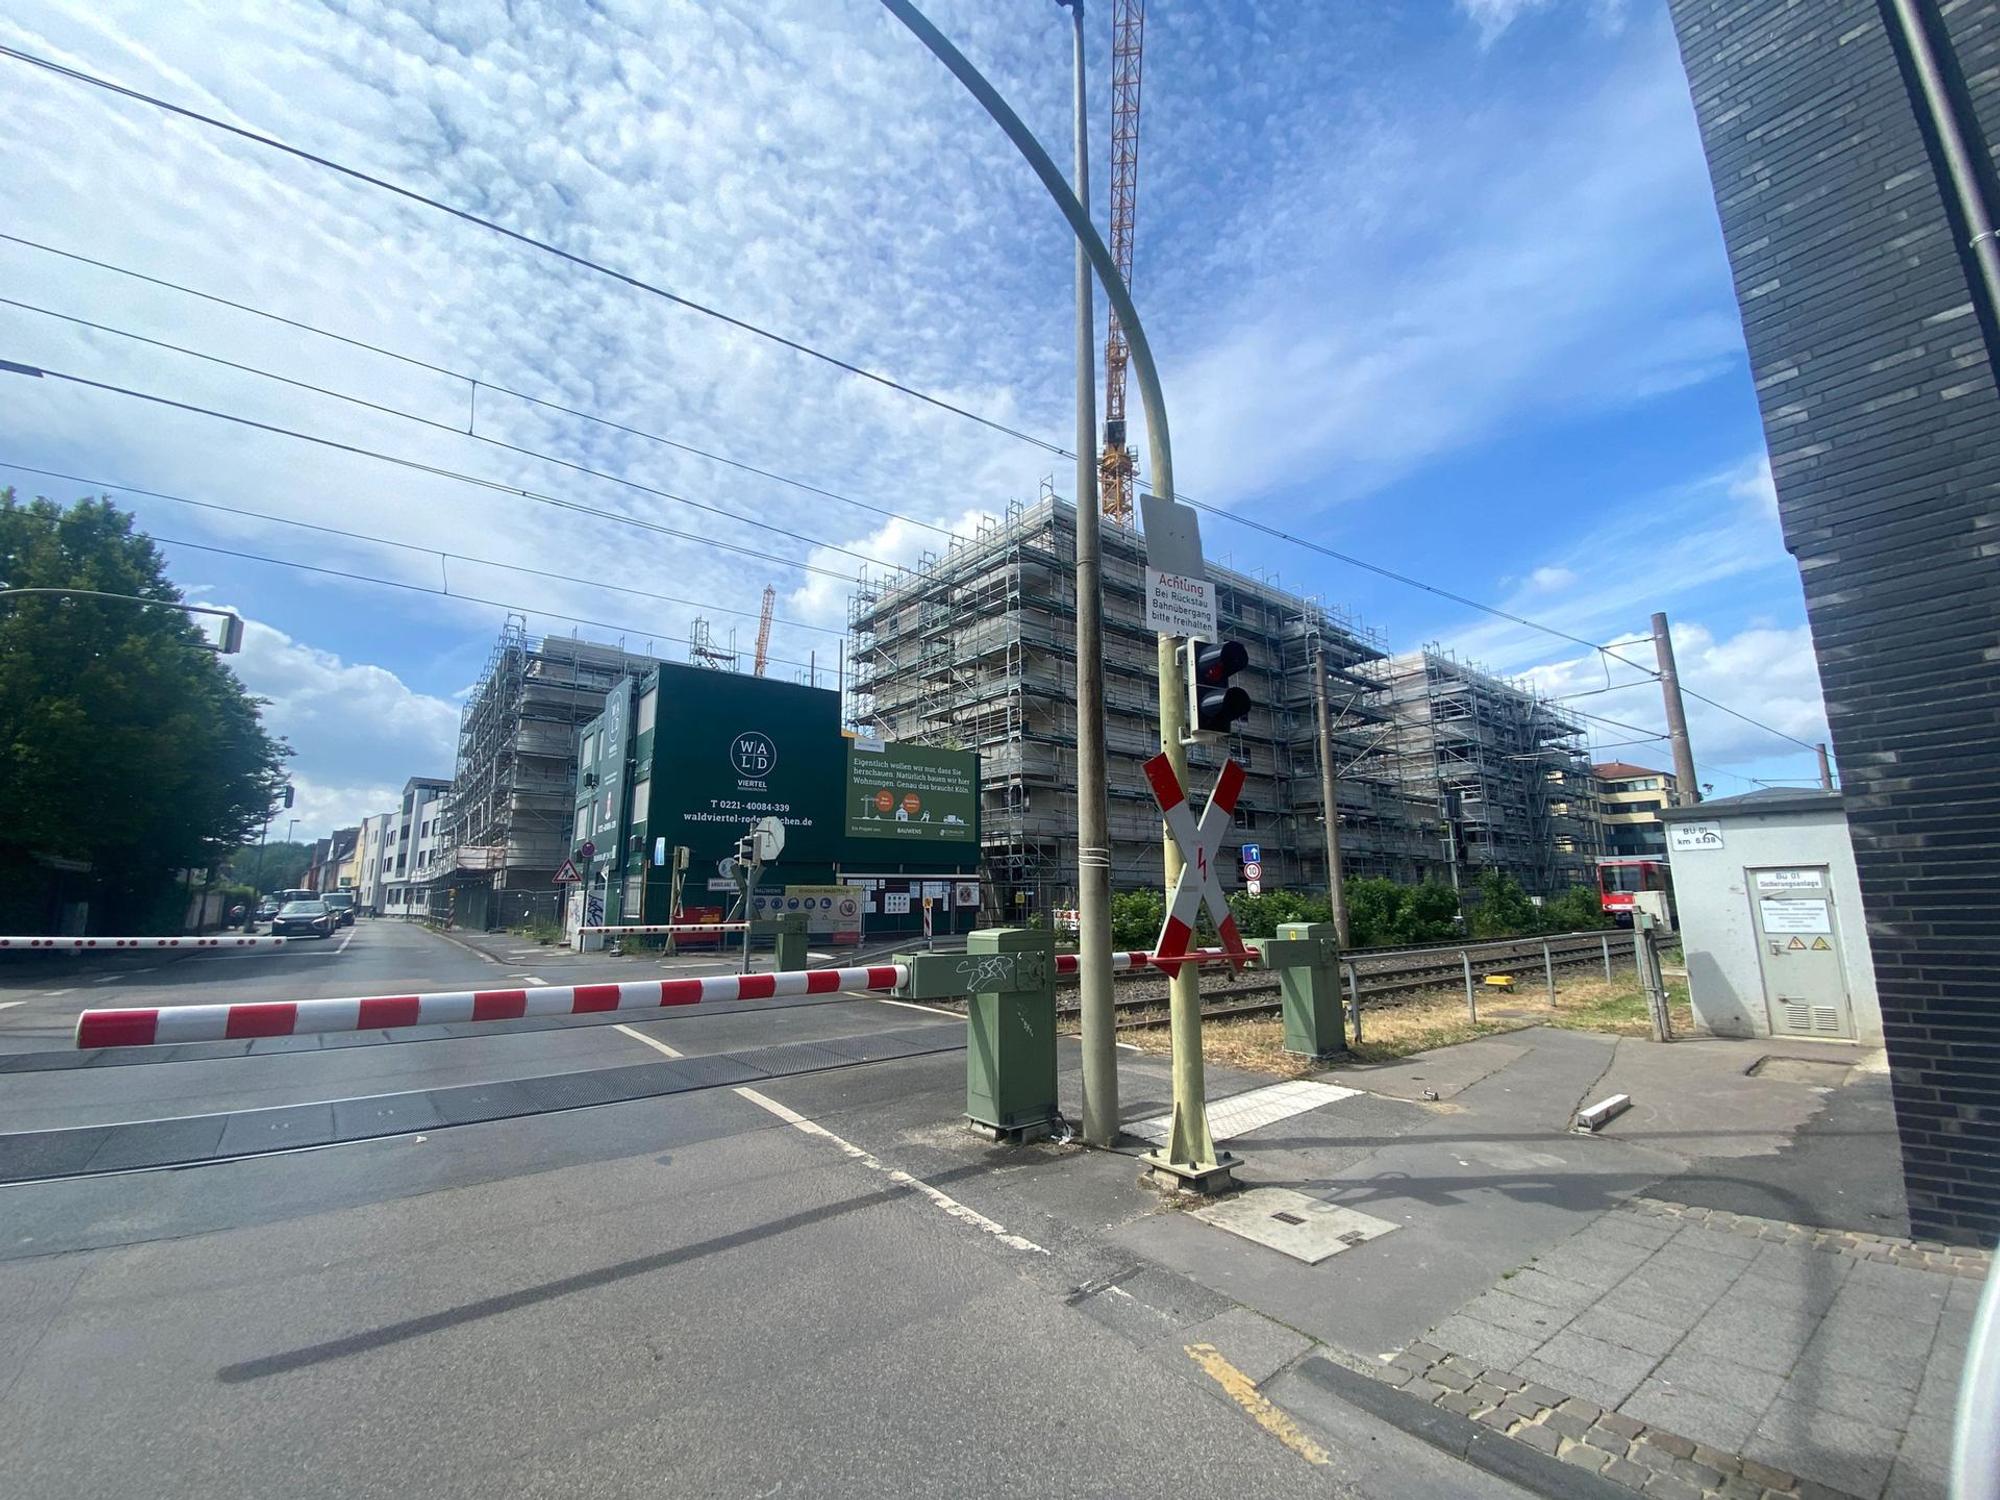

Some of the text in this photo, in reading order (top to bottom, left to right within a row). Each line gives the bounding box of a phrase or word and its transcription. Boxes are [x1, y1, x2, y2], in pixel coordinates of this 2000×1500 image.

[1160, 573, 1204, 597] Achtung
[1155, 587, 1208, 608] Bei Rückstau
[1152, 599, 1211, 622] Bahnübergang
[1152, 611, 1213, 631] bitte freihalten
[854, 758, 889, 767] Eigentlich
[913, 764, 923, 772] wir
[937, 766, 952, 774] dass
[737, 780, 767, 788] VIERTEL
[853, 776, 970, 794] Wohnungen. Genau das braucht Köln.
[896, 771, 926, 781] Natürlich
[927, 774, 946, 783] bauen
[947, 776, 957, 784] wir
[958, 776, 970, 785] hier
[711, 800, 790, 812] T 0221-40084-339
[1698, 826, 1708, 834] 01
[1248, 866, 1257, 876] 10
